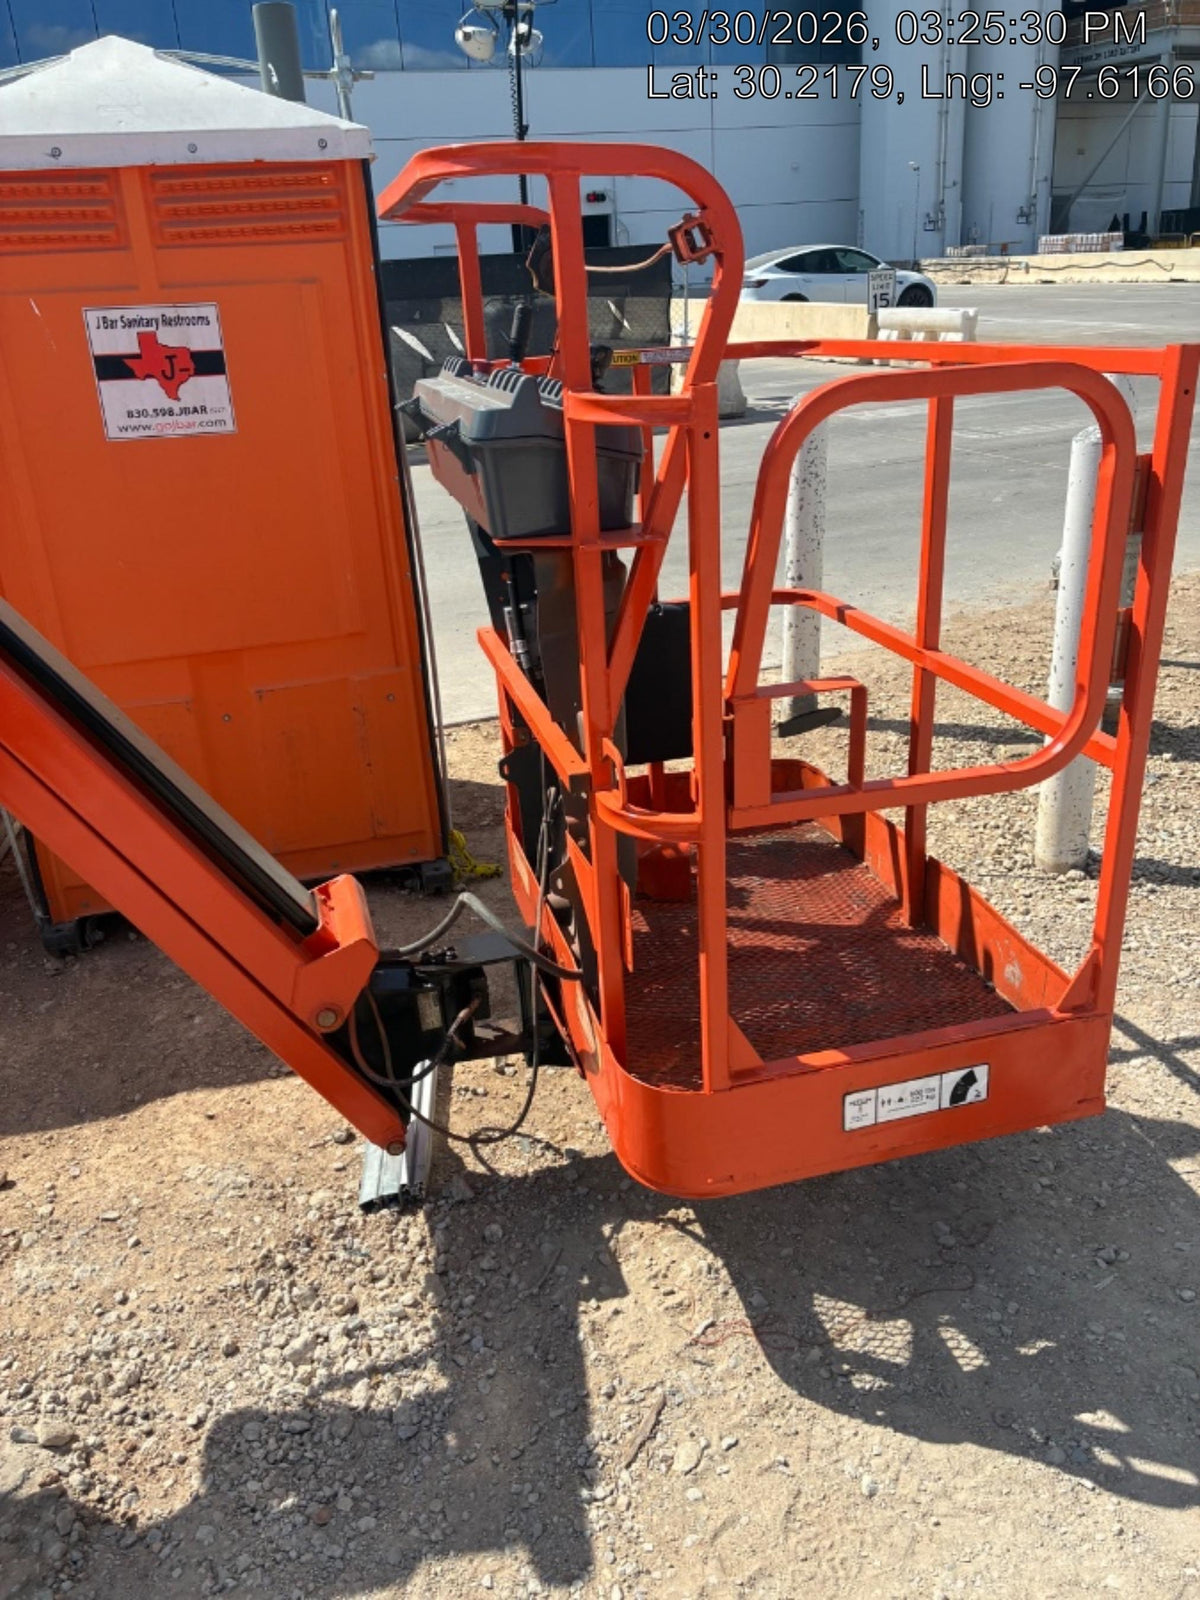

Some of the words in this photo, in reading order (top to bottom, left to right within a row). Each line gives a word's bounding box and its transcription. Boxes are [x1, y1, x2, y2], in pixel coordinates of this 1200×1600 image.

[870, 273, 893, 281] SPEED
[872, 282, 891, 291] LIMIT
[872, 292, 890, 310] 15
[96, 316, 101, 330] J
[102, 315, 119, 330] Bar
[120, 314, 160, 331] Sanitary
[161, 313, 211, 328] Restrooms
[611, 353, 637, 364] UTION
[117, 418, 227, 433] www.gojbar.com
